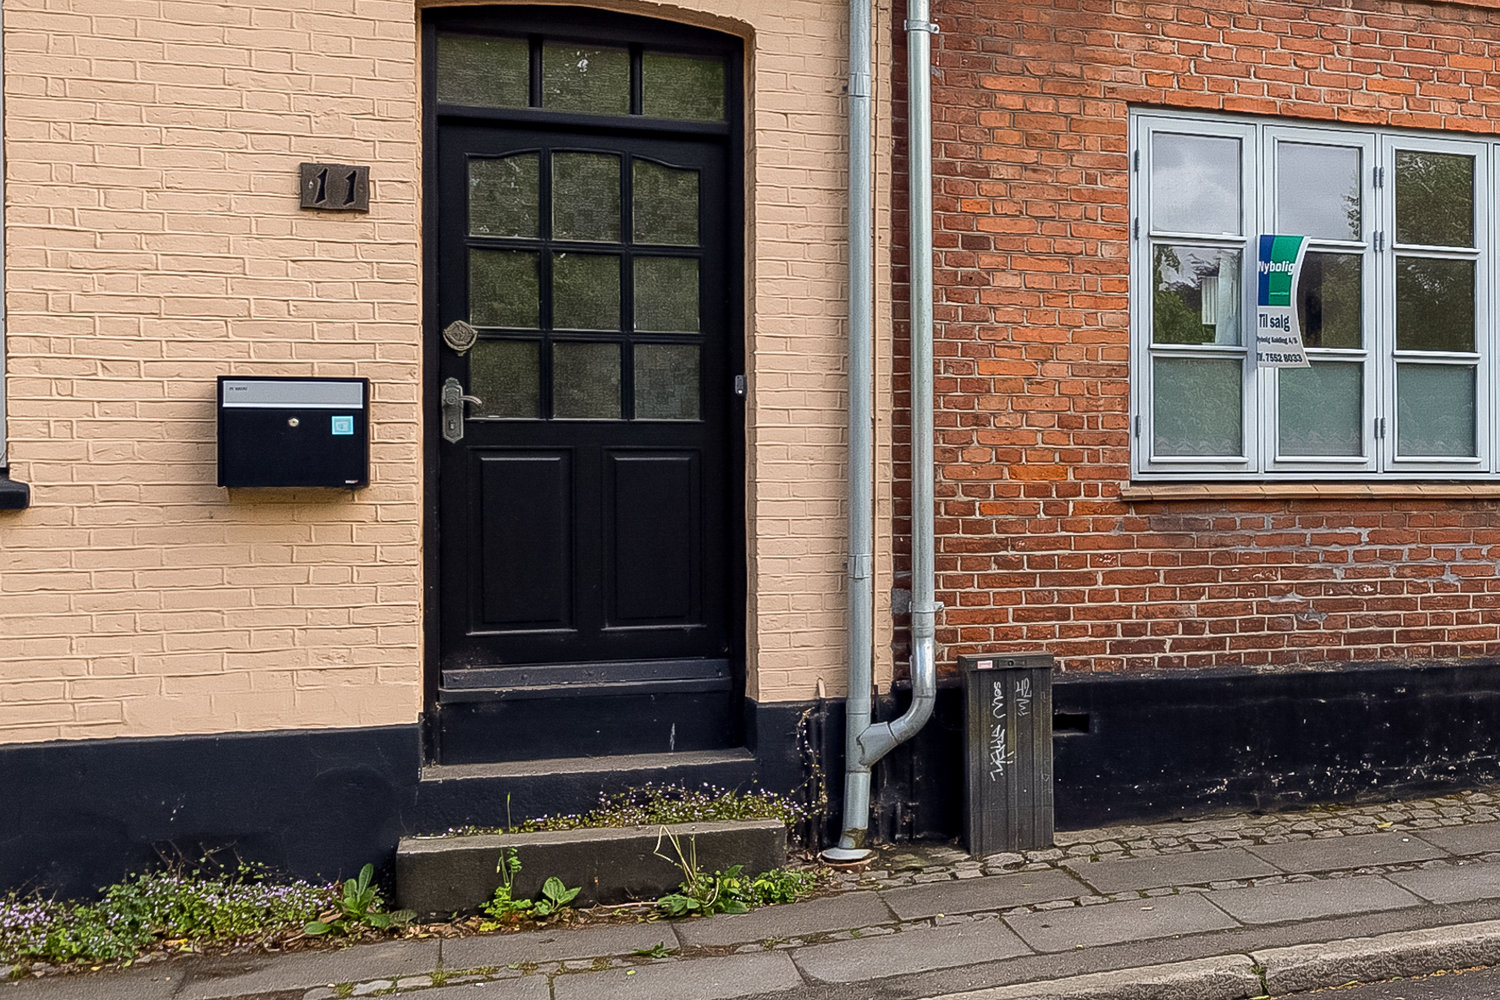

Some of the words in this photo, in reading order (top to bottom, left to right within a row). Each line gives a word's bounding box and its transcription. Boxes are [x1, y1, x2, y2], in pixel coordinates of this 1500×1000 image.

[314, 167, 357, 206] 11
[1257, 260, 1296, 276] Nybolig
[1259, 313, 1268, 328] Til
[1270, 313, 1291, 332] salg
[1265, 353, 1283, 362] 7552
